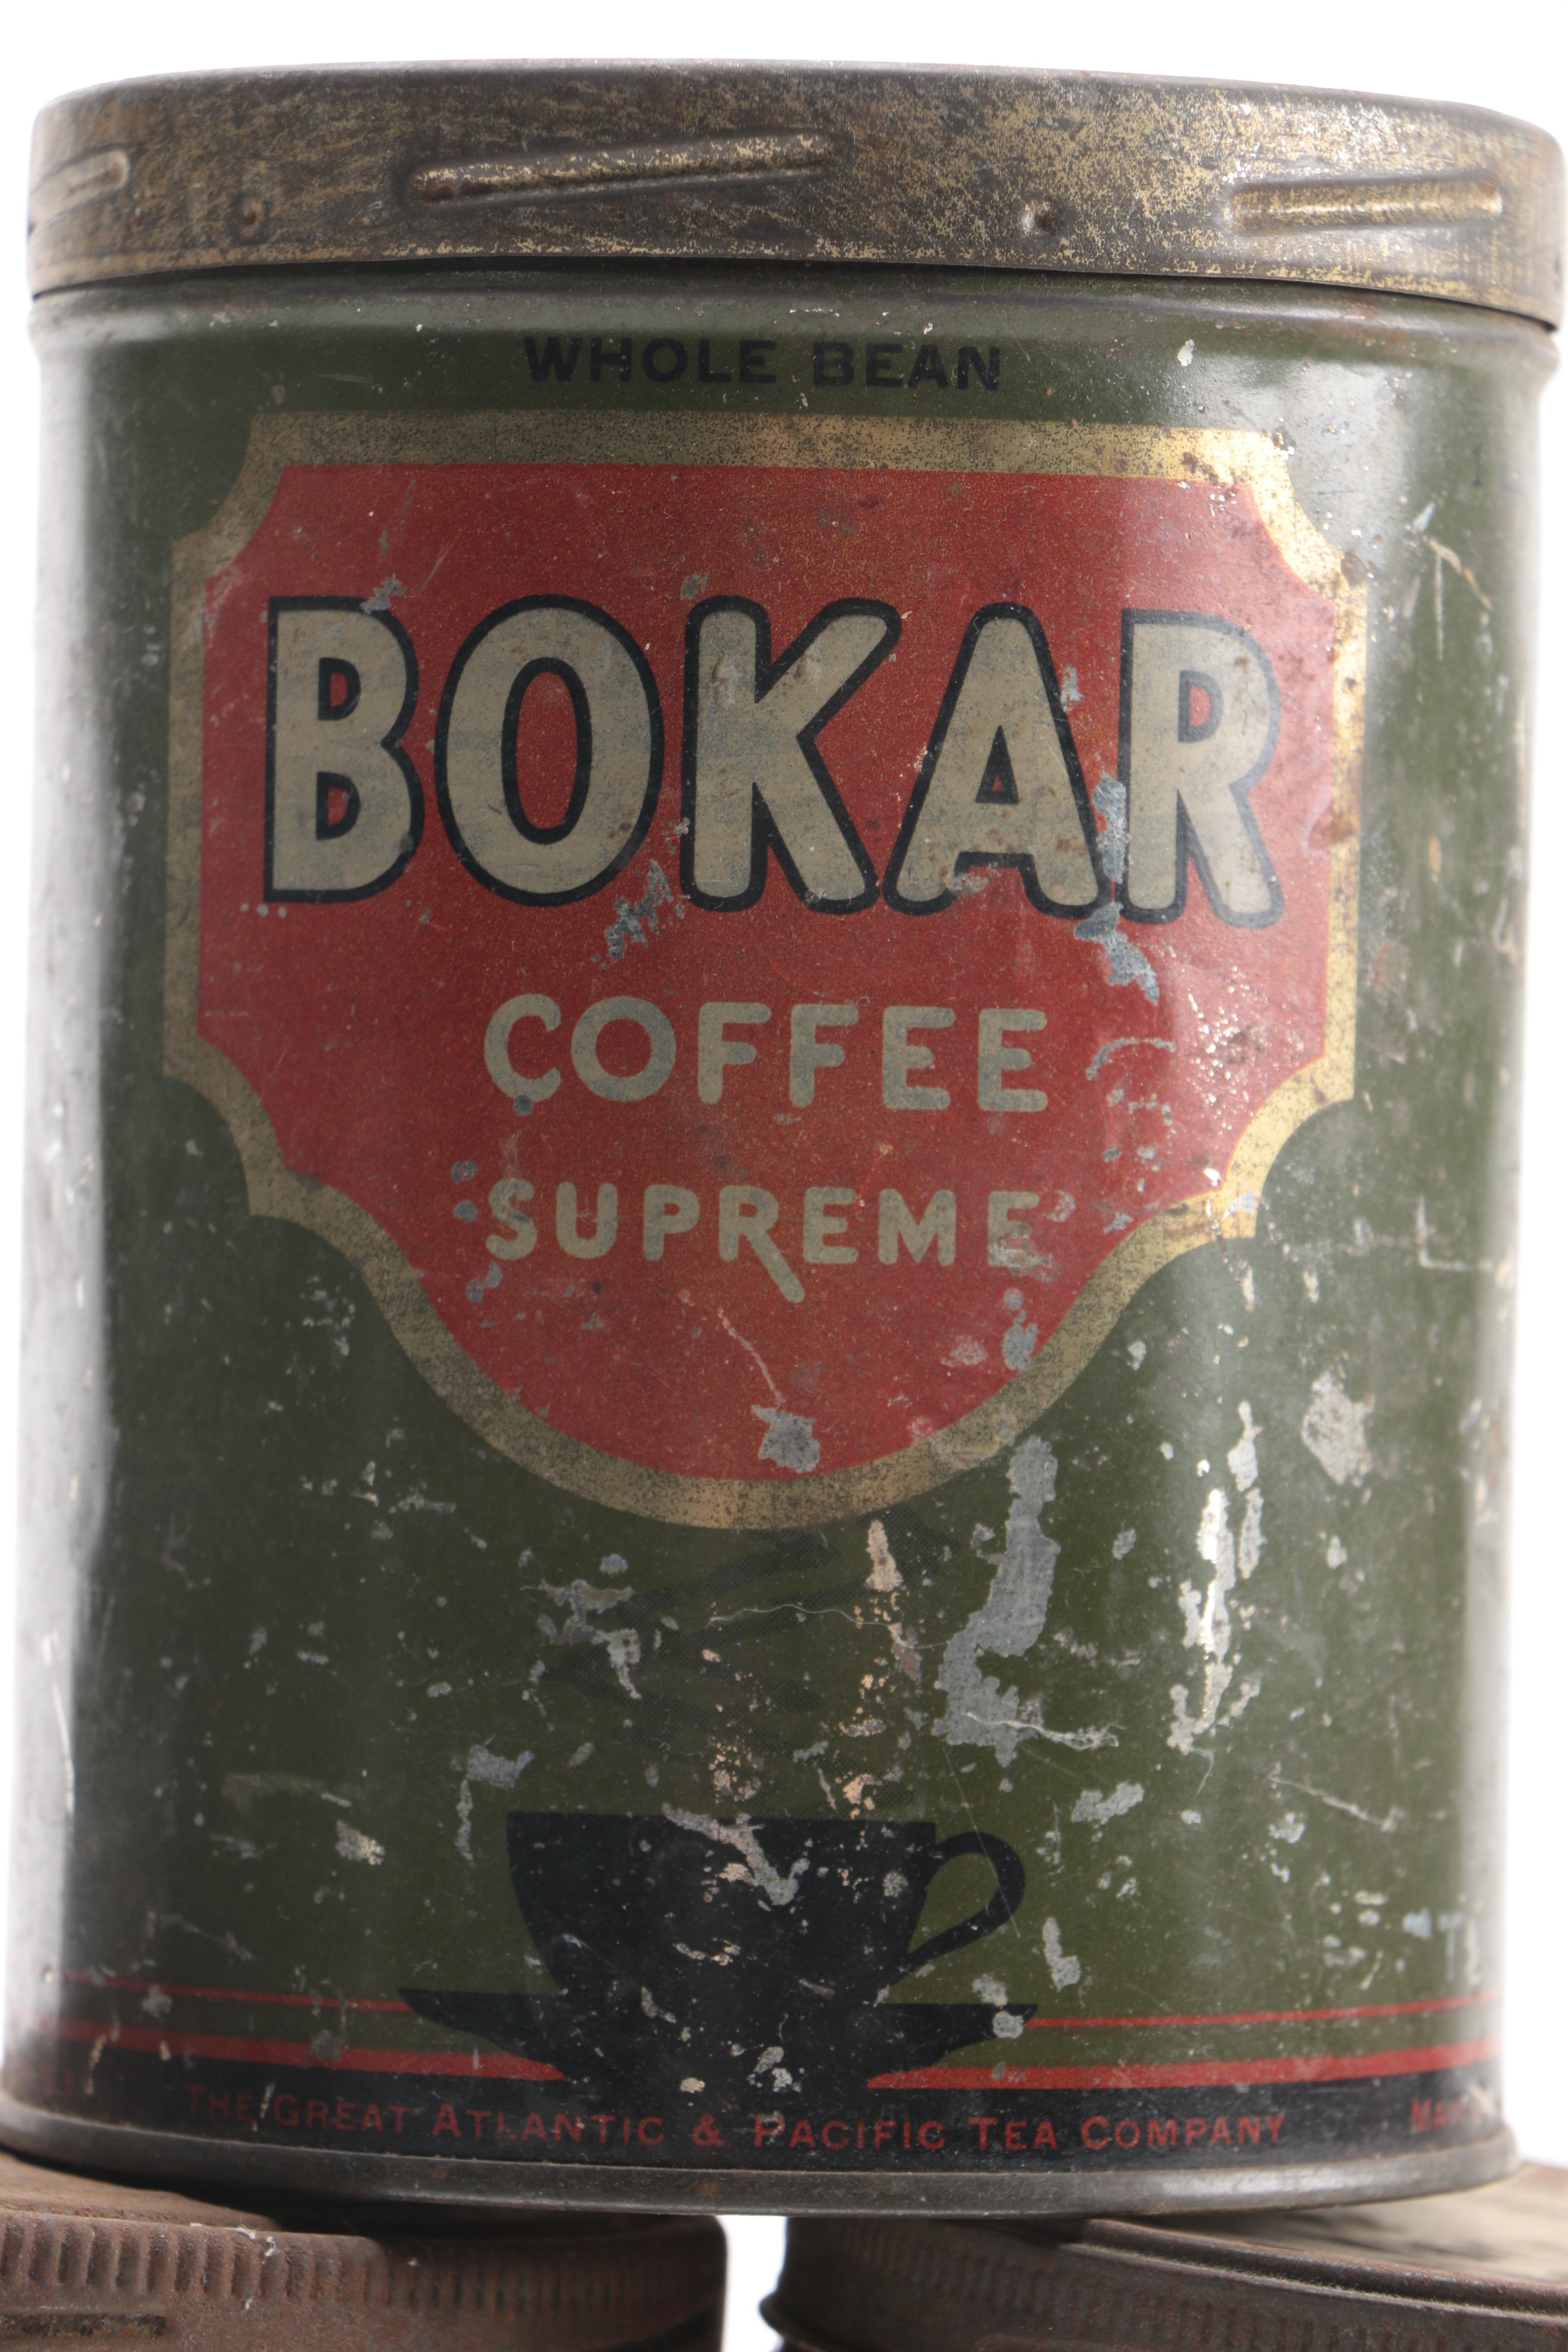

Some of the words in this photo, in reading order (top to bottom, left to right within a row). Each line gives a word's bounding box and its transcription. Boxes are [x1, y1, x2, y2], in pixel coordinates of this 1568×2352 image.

[522, 336, 776, 383] WHOLE
[812, 342, 1001, 390] BEAN
[263, 594, 1284, 926] BOKAR
[484, 993, 1049, 1112] COFFEE
[485, 1177, 1042, 1302] SUPREME
[185, 2084, 254, 2122] THE
[273, 2093, 410, 2135] GREAT
[432, 2104, 665, 2144] ATLANTIC
[693, 2113, 726, 2146] &
[754, 2113, 946, 2150] PACIFIC
[968, 2117, 1058, 2150] TEA
[1081, 2114, 1284, 2150] COMPANY
